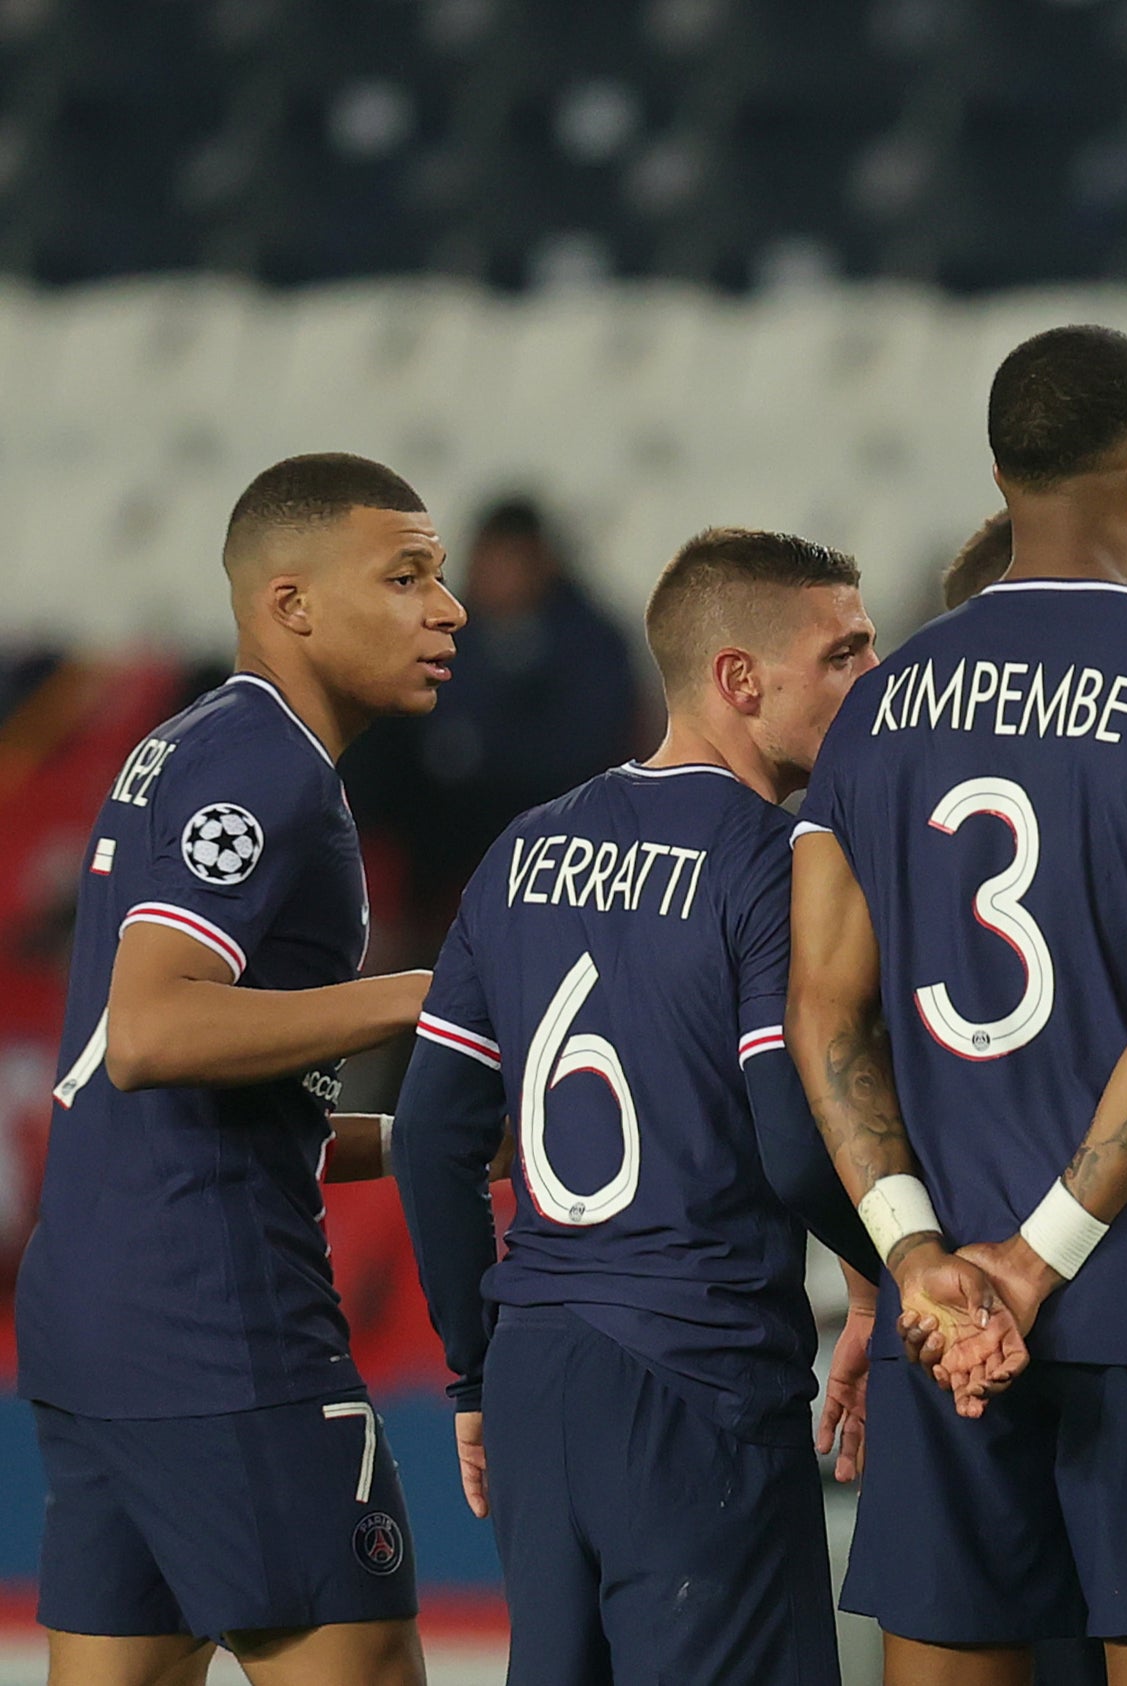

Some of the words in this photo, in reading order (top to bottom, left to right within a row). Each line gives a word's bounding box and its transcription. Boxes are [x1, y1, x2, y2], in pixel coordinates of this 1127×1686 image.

[508, 834, 707, 920] VERRATTI
[914, 776, 1056, 1063] 3
[519, 951, 640, 1228] 6
[322, 1401, 376, 1504] 7
